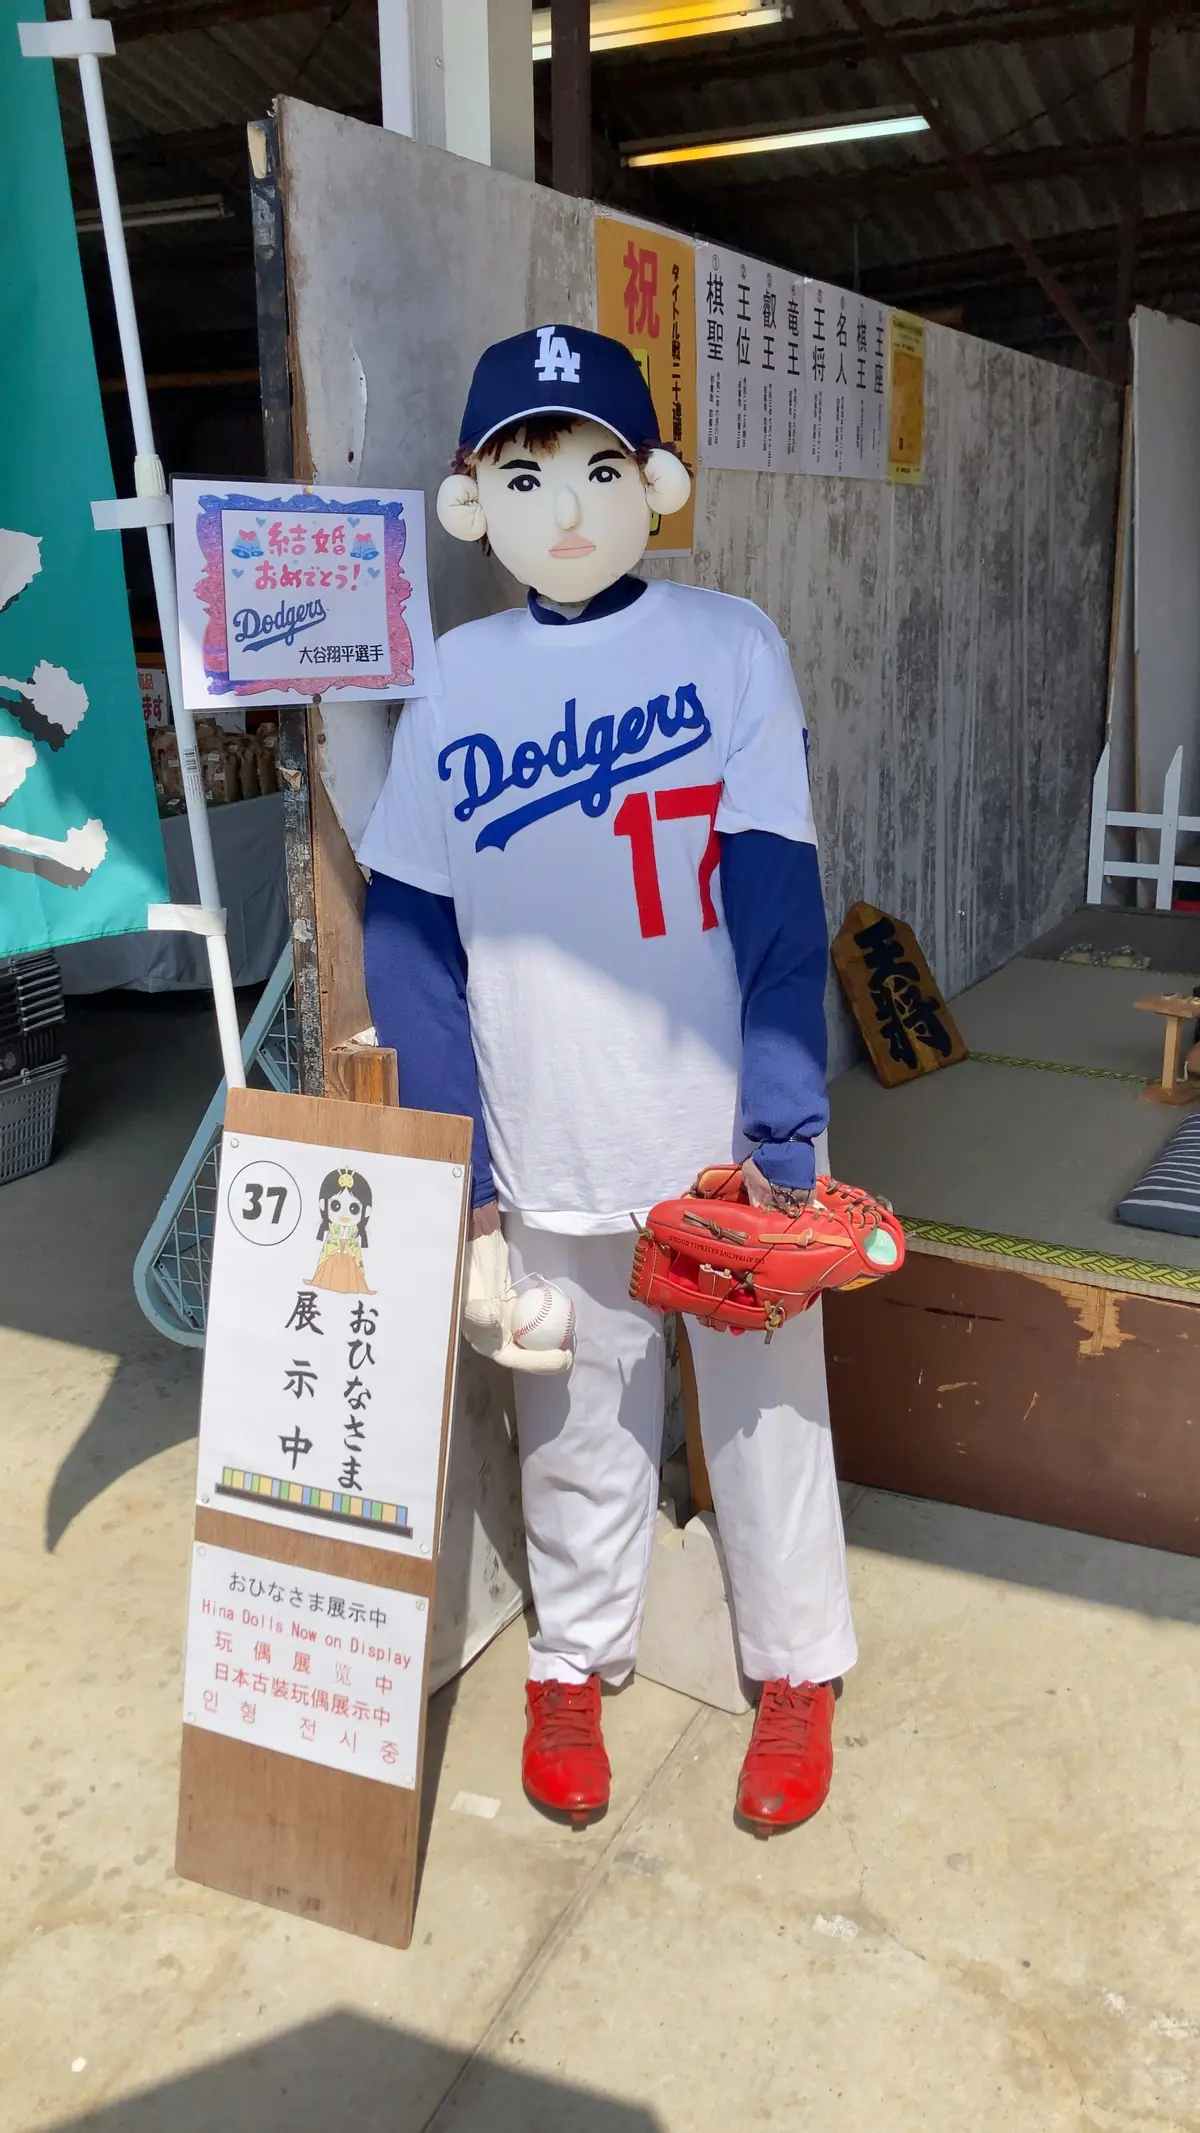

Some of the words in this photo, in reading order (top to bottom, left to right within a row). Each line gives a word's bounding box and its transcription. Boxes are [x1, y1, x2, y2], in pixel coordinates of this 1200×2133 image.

[622, 239, 660, 338] 祝
[706, 271, 724, 361] 棋聖
[534, 326, 580, 383] LA
[736, 284, 751, 366] 王位
[812, 307, 826, 382] 王将
[836, 312, 847, 385] 名人
[268, 521, 346, 557] 結婚
[232, 598, 327, 648] Dodgers
[299, 644, 384, 664] 大谷翔平選手
[437, 682, 713, 822] Dodgers
[613, 781, 724, 938] 17
[242, 1182, 288, 1225] 37
[668, 1235, 690, 1246] GOODS
[690, 1242, 719, 1255] BASEBALL
[720, 1250, 753, 1263] ATTRACTIVE
[278, 1290, 325, 1471] 展示中
[337, 1299, 379, 1492] おひなさま
[201, 1598, 235, 1621] Hina
[242, 1608, 283, 1633] Dolls
[291, 1620, 317, 1643] Now
[324, 1634, 342, 1649] on
[350, 1637, 412, 1670] Display
[229, 1571, 387, 1629] おひなさま展示中
[214, 1662, 391, 1728] 日本古裝玩偶展示中
